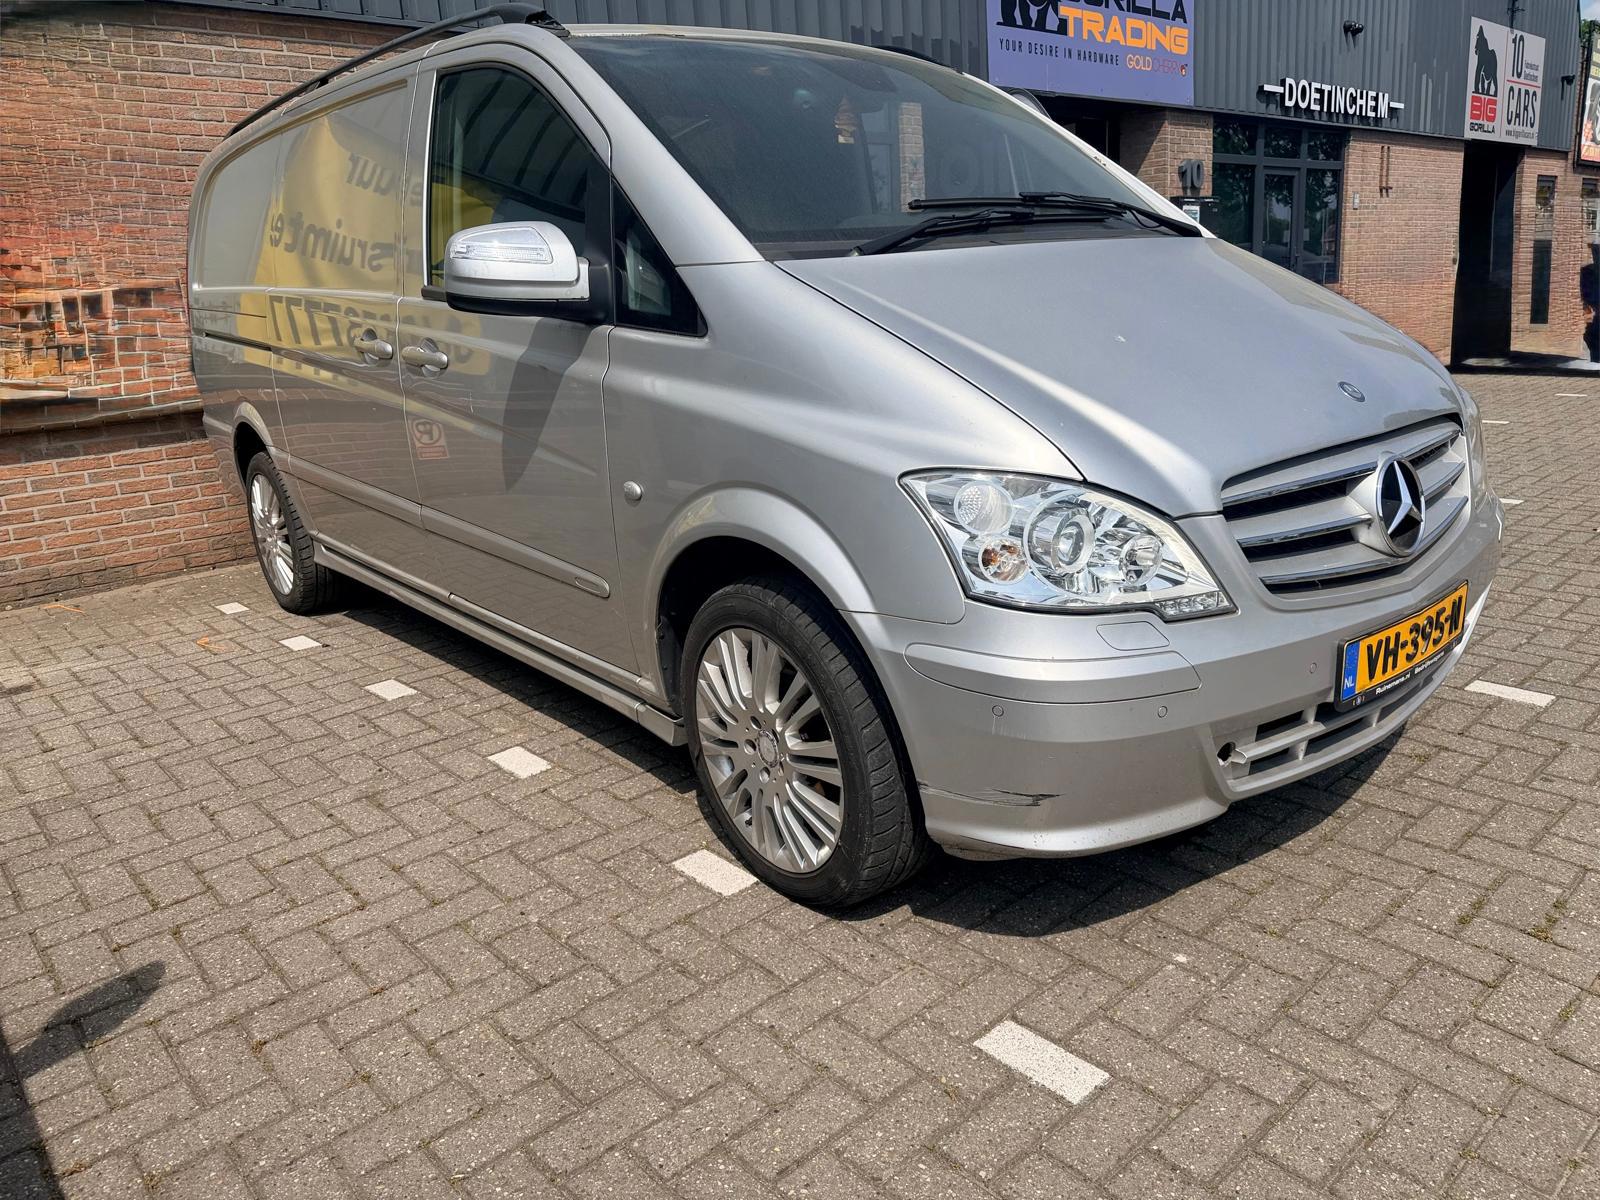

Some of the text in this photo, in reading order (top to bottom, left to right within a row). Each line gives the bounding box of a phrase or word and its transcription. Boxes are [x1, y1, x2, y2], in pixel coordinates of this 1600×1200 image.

[1059, 6, 1189, 55] TRADING
[999, 38, 1120, 66] YOUR DESIRE IN HARDWARE
[1511, 34, 1525, 79] 10
[1284, 77, 1389, 119] DOETINCHEM
[1469, 95, 1498, 123] BIG
[1506, 86, 1537, 128] CARS
[1469, 122, 1496, 134] GORILLA
[1178, 159, 1205, 189] 10
[1366, 594, 1464, 682] VH-395-N
[1343, 675, 1355, 690] NL
